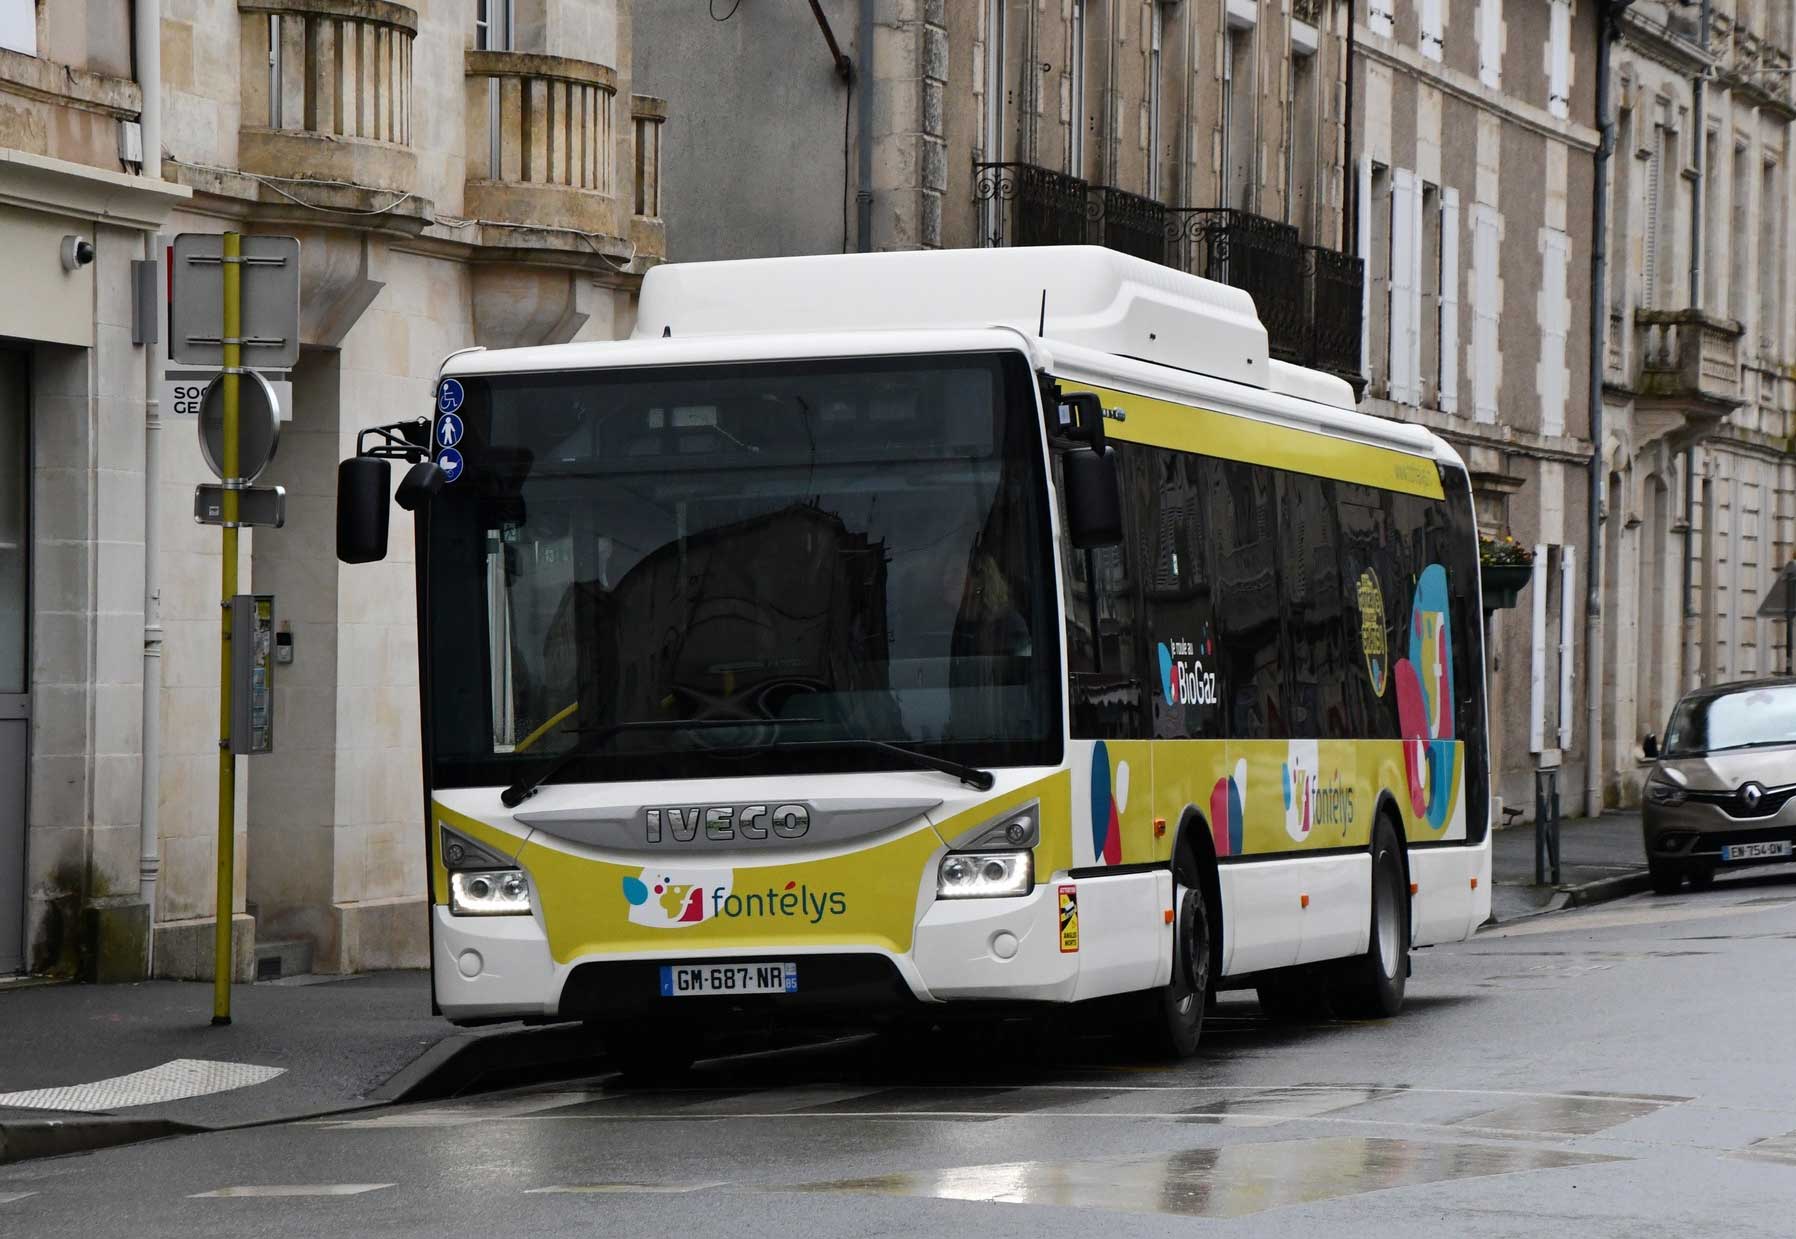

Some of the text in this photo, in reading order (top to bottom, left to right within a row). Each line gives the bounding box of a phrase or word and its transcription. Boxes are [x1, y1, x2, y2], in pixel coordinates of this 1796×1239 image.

[1177, 660, 1217, 705] BioGaz
[646, 803, 811, 844] IVECO
[1312, 768, 1354, 838] fontélys
[711, 880, 847, 924] fontélys
[677, 966, 783, 991] GM-687-NR
[785, 977, 797, 989] 85
